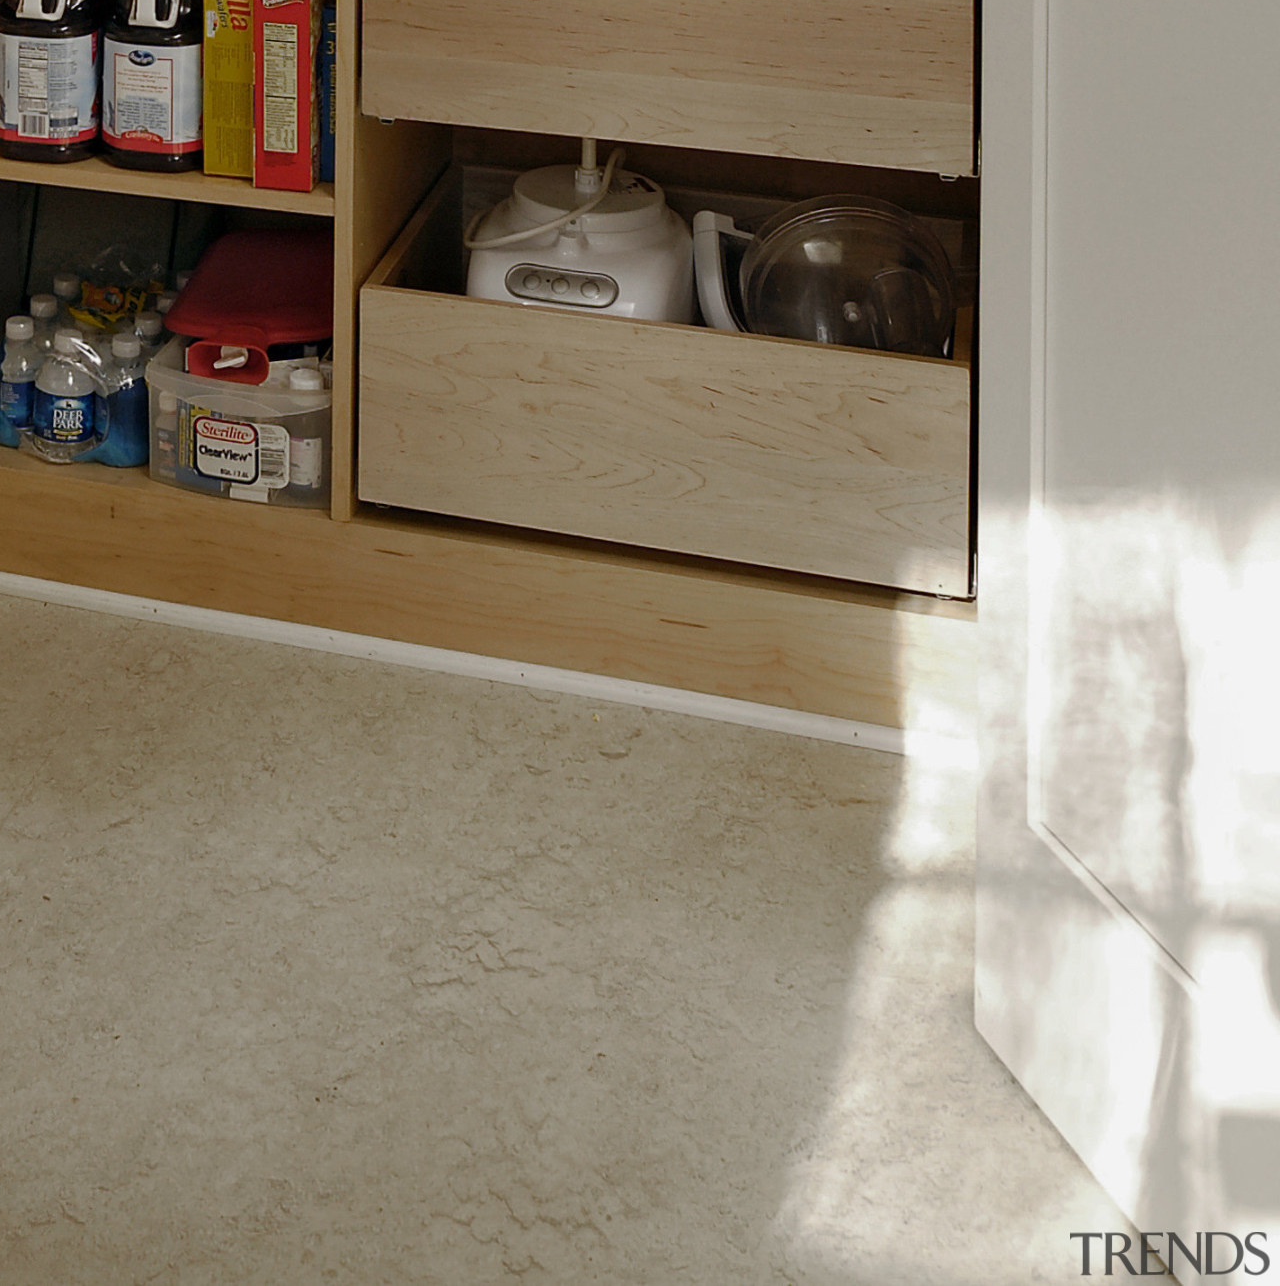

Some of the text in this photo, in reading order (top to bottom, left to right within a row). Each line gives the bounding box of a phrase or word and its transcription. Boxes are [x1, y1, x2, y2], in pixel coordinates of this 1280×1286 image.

[53, 409, 83, 421] DEER
[52, 419, 84, 430] PARK
[201, 422, 250, 441] Sterilite
